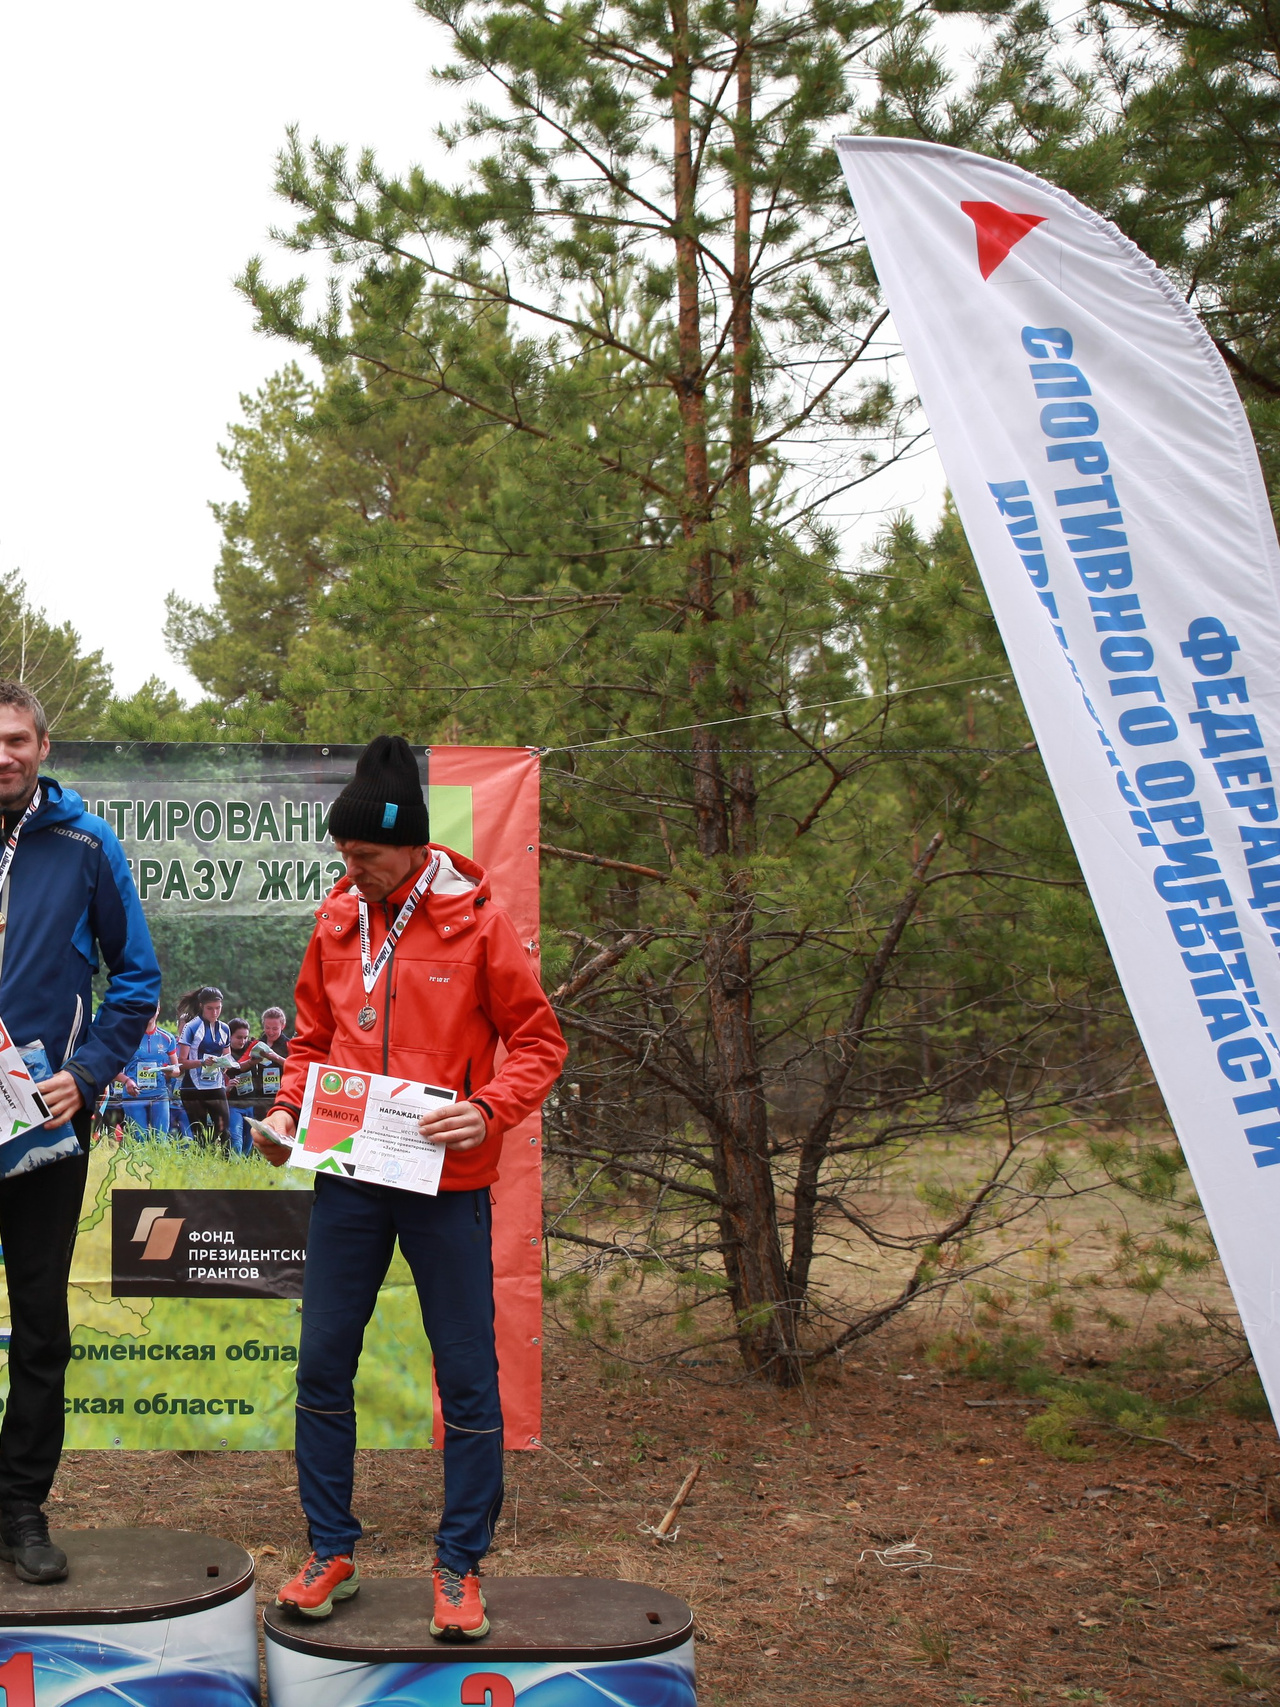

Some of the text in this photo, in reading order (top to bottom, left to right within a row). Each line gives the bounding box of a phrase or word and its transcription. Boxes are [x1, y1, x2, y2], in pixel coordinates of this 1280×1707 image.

[1021, 325, 1179, 747] СПОРТИВНОГО
[50, 826, 99, 850] noname
[127, 858, 244, 901] РАЗУ
[315, 1106, 360, 1123] ГРАМОТА
[188, 1230, 234, 1244] ФОНД
[188, 1267, 259, 1278] ГРАНТОВ
[225, 1340, 297, 1361] обла
[133, 1393, 255, 1415] область
